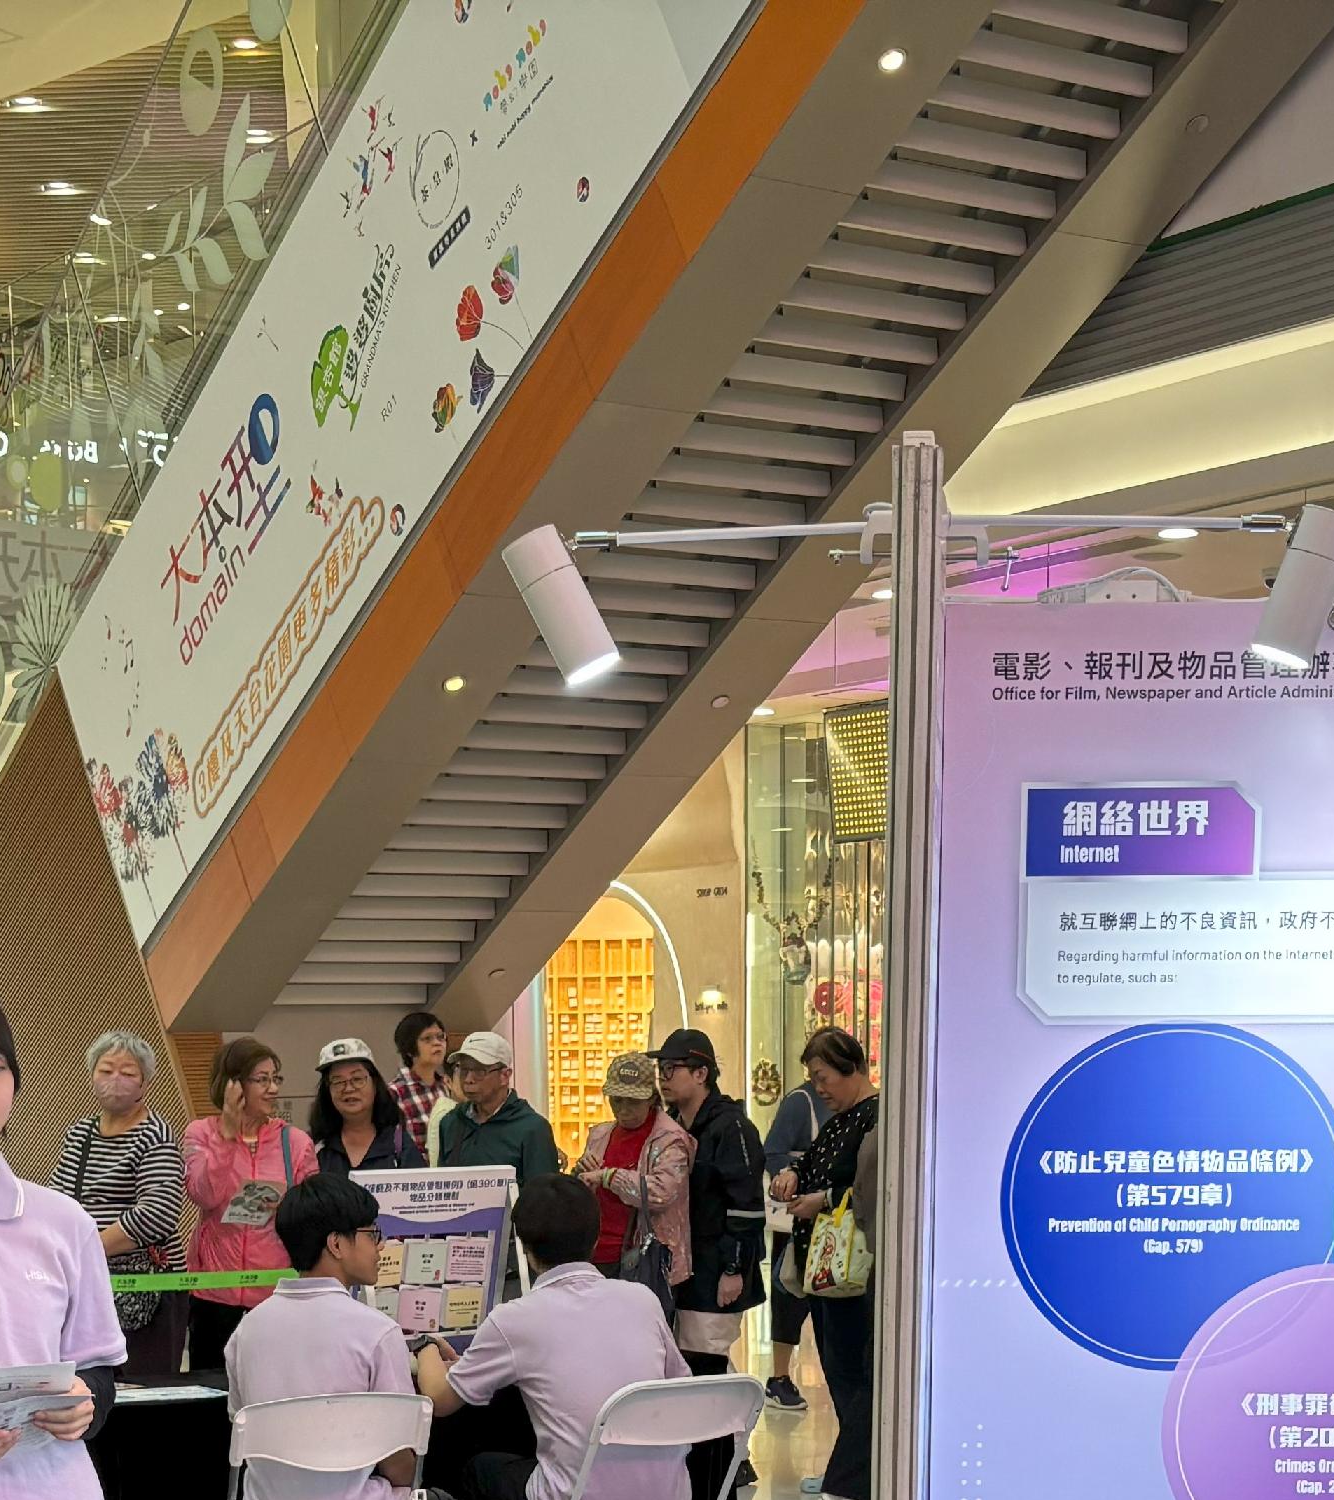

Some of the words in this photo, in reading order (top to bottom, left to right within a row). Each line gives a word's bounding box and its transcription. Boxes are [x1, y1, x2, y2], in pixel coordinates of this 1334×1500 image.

[360, 320, 386, 388] GRANDMA'S
[384, 263, 402, 318] KITCHEN
[179, 544, 245, 665] domain
[992, 687, 1036, 700] Office
[1040, 687, 1061, 700] for
[1065, 687, 1101, 702] Film,
[1105, 687, 1191, 702] Newspaper
[1195, 686, 1223, 699] and
[1227, 686, 1276, 699] Article
[1062, 799, 1209, 837] 網絡世界
[1060, 844, 1120, 863] Internet
[1057, 950, 1119, 964] Regarding
[1122, 950, 1168, 962] harmful
[1172, 949, 1242, 961] information
[1245, 951, 1260, 961] on
[1263, 950, 1283, 961] the
[1057, 973, 1068, 984] to
[1072, 972, 1125, 986] regulate,
[1128, 972, 1156, 984] such
[1039, 1149, 1314, 1175] 《防止兒童色情物品條例》
[1048, 1217, 1112, 1233] Prevention
[1114, 1218, 1127, 1232] of
[1129, 1217, 1159, 1232] Child
[1161, 1217, 1237, 1234] Pornography
[1240, 1217, 1301, 1231] Ordinance
[1143, 1239, 1173, 1254] (Cap.
[1175, 1238, 1204, 1254] 579)
[1275, 1459, 1316, 1474] Crimes
[1296, 1480, 1326, 1495] (Cap.
